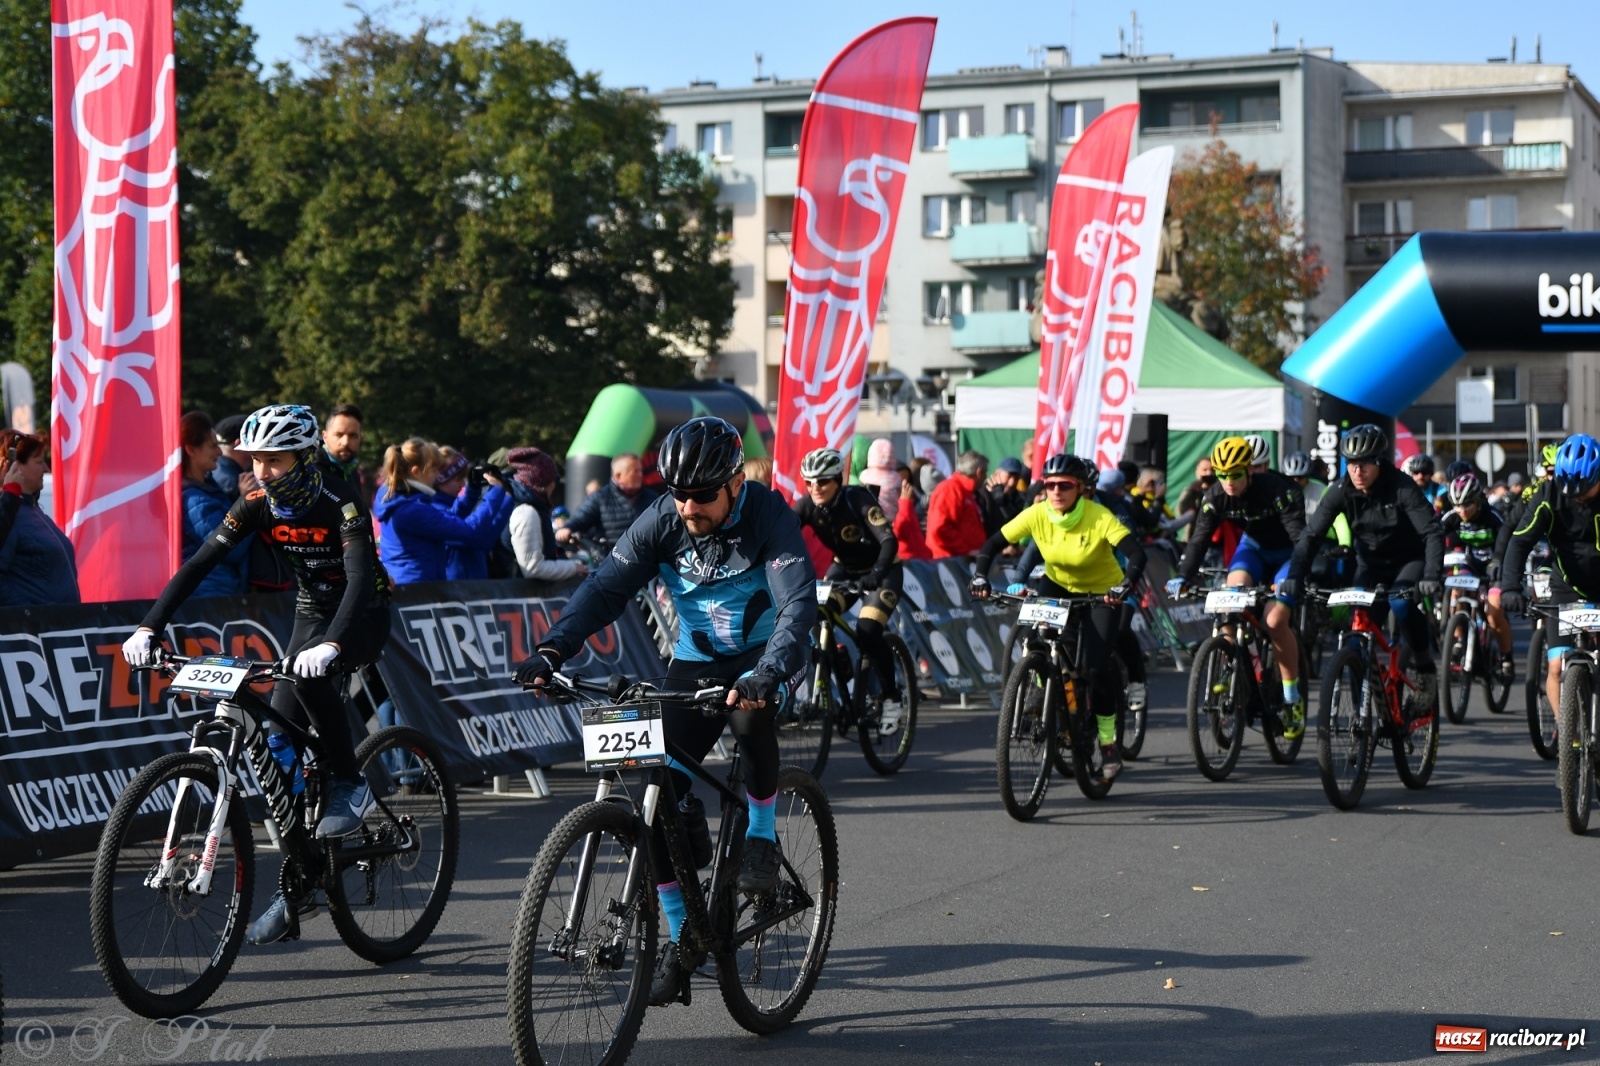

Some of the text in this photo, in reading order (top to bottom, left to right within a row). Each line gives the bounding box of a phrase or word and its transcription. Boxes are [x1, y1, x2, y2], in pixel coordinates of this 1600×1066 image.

[1538, 272, 1600, 318] bik
[1096, 193, 1146, 470] RACIBÓRZ
[272, 525, 329, 543] CST
[188, 669, 233, 684] 3290
[457, 705, 573, 757] USZCZELNIAMY
[597, 730, 652, 753] 2254
